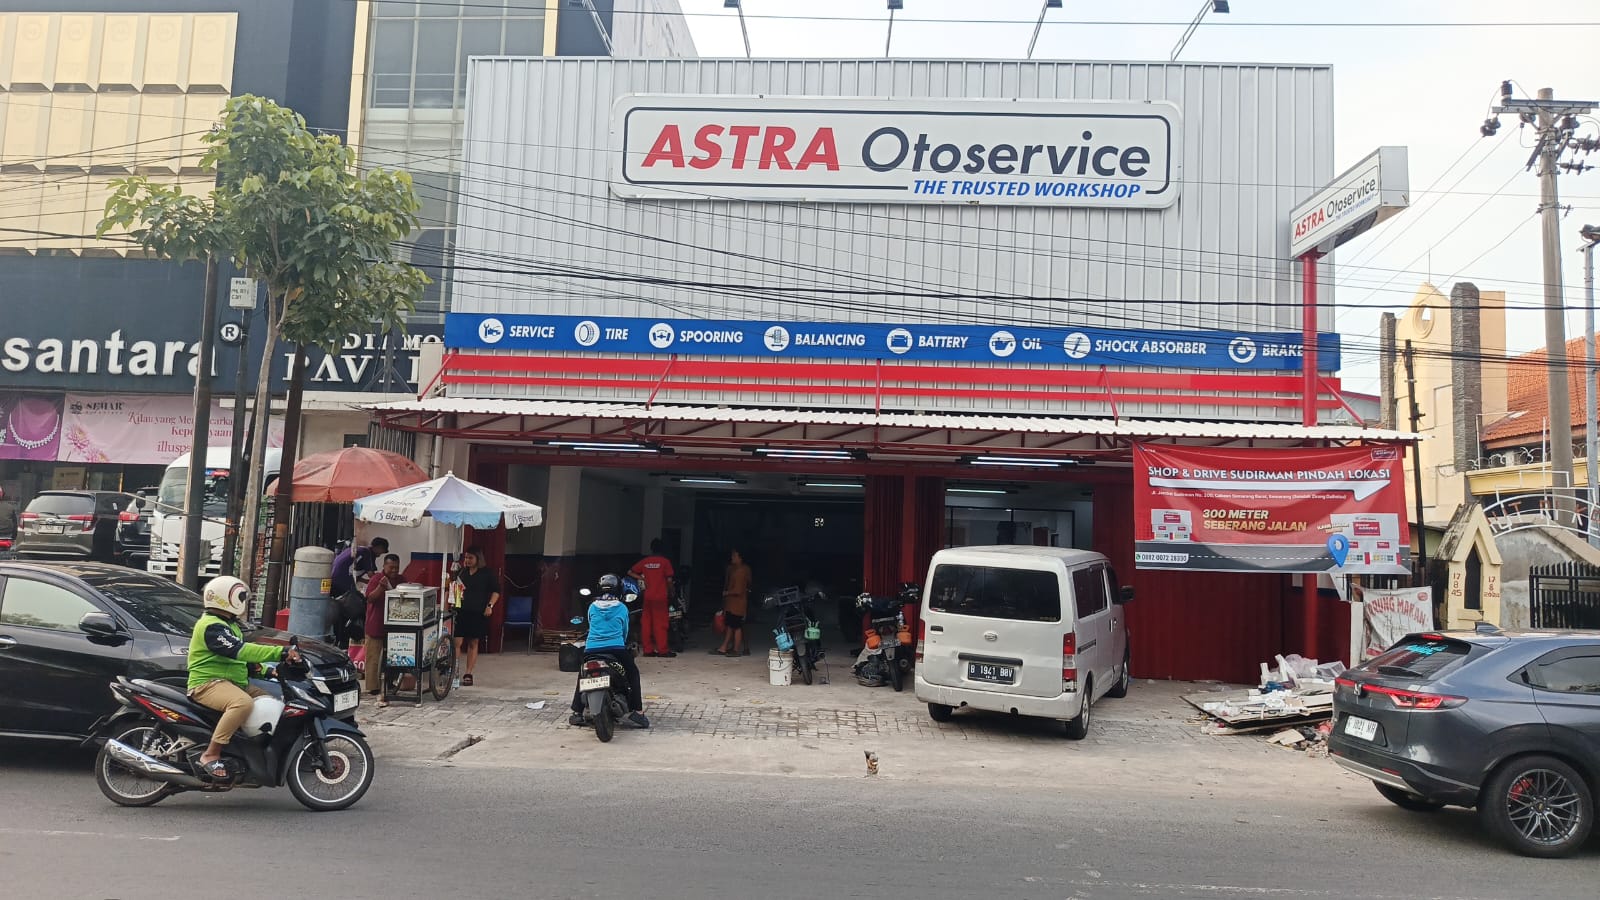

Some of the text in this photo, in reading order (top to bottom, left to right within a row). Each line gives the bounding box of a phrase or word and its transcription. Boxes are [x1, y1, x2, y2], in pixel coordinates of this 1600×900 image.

[641, 124, 1150, 177] ASTRA Otoservice
[913, 180, 1141, 199] THE TRUSTED WORKSHOP
[1294, 178, 1376, 240] ASTRA Otoservice
[509, 325, 555, 338] SERVICE
[605, 328, 629, 340] TIRE
[680, 330, 743, 343] SPOORING
[795, 333, 866, 347] BALANCING
[918, 335, 968, 349] BATTERY
[1095, 339, 1207, 355] SHOCK ABSORBER
[1148, 466, 1390, 480] SHOP & DRIVE SUDIRMAN PINDAH LOKASI
[385, 512, 409, 522] Biznet
[1203, 509, 1269, 519] 300 METER
[1203, 520, 1265, 531] SEBERANG
[1268, 521, 1307, 531] JALAN
[1453, 580, 1459, 589] 8
[980, 665, 996, 676] 1941
